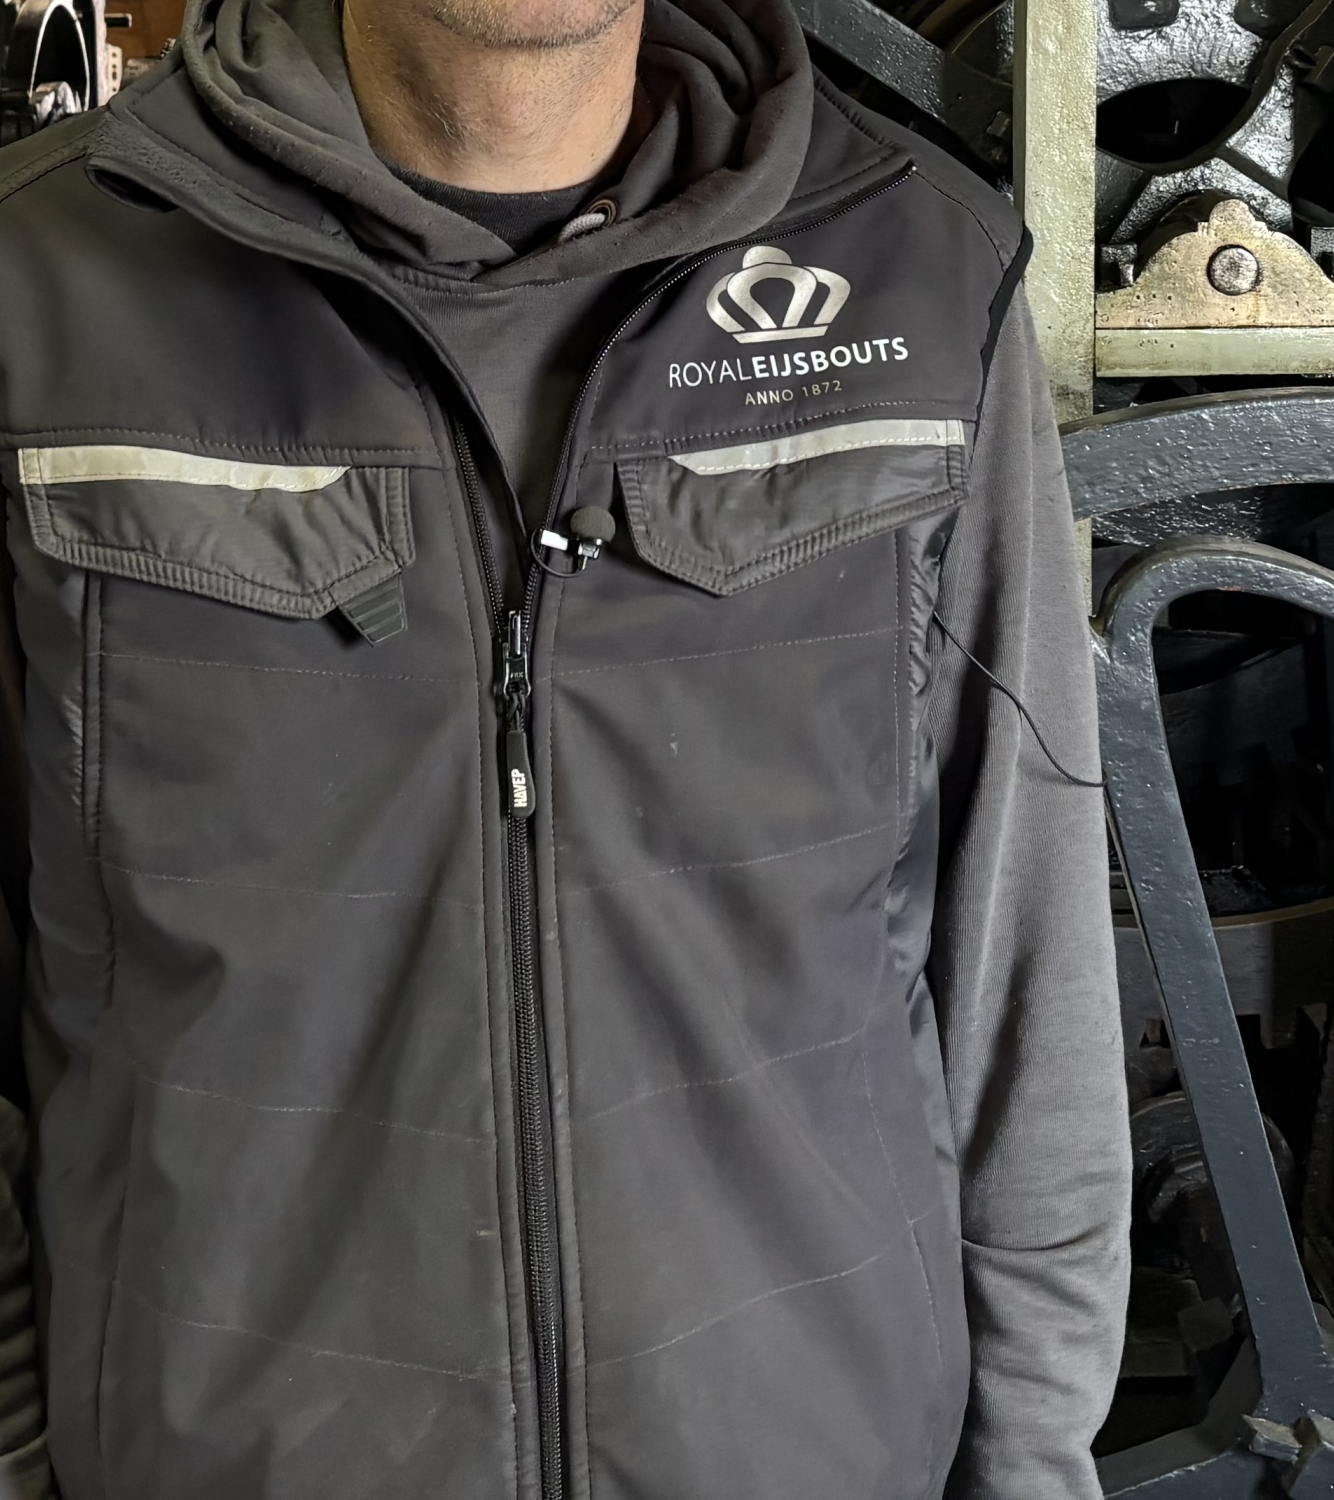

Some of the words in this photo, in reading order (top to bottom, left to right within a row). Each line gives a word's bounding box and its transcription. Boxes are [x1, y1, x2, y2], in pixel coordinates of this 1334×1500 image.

[745, 388, 794, 405] ANNO
[802, 380, 843, 397] 1872
[511, 768, 527, 807] HAVEP
